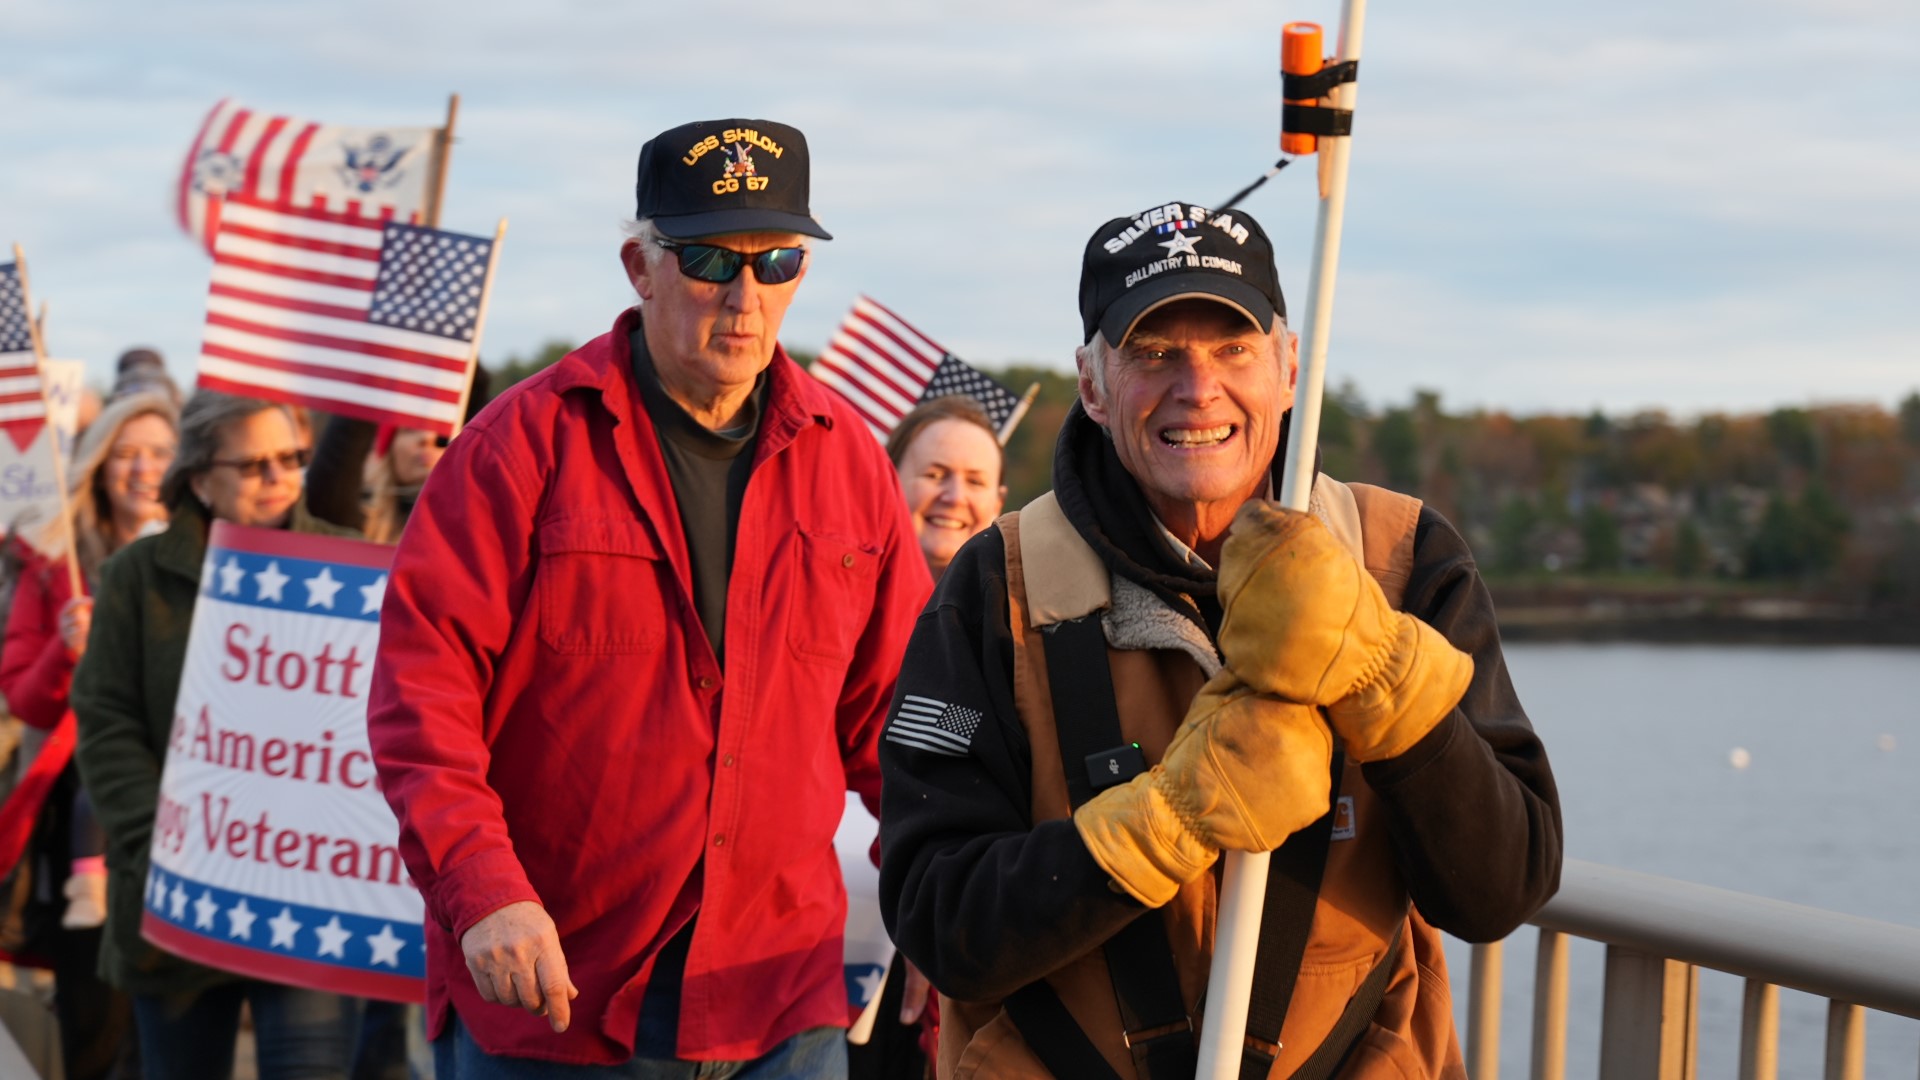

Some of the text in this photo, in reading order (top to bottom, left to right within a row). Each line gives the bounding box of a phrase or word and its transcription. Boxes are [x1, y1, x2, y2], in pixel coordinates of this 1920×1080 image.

[682, 128, 784, 167] USS SHILOH
[712, 176, 769, 196] CG 67
[1103, 203, 1184, 254] SILVER
[1125, 254, 1243, 288] GALLANTRY IN COMBAT
[221, 622, 363, 699] Stott
[188, 704, 384, 794] Americ
[200, 792, 420, 890] Veteran
